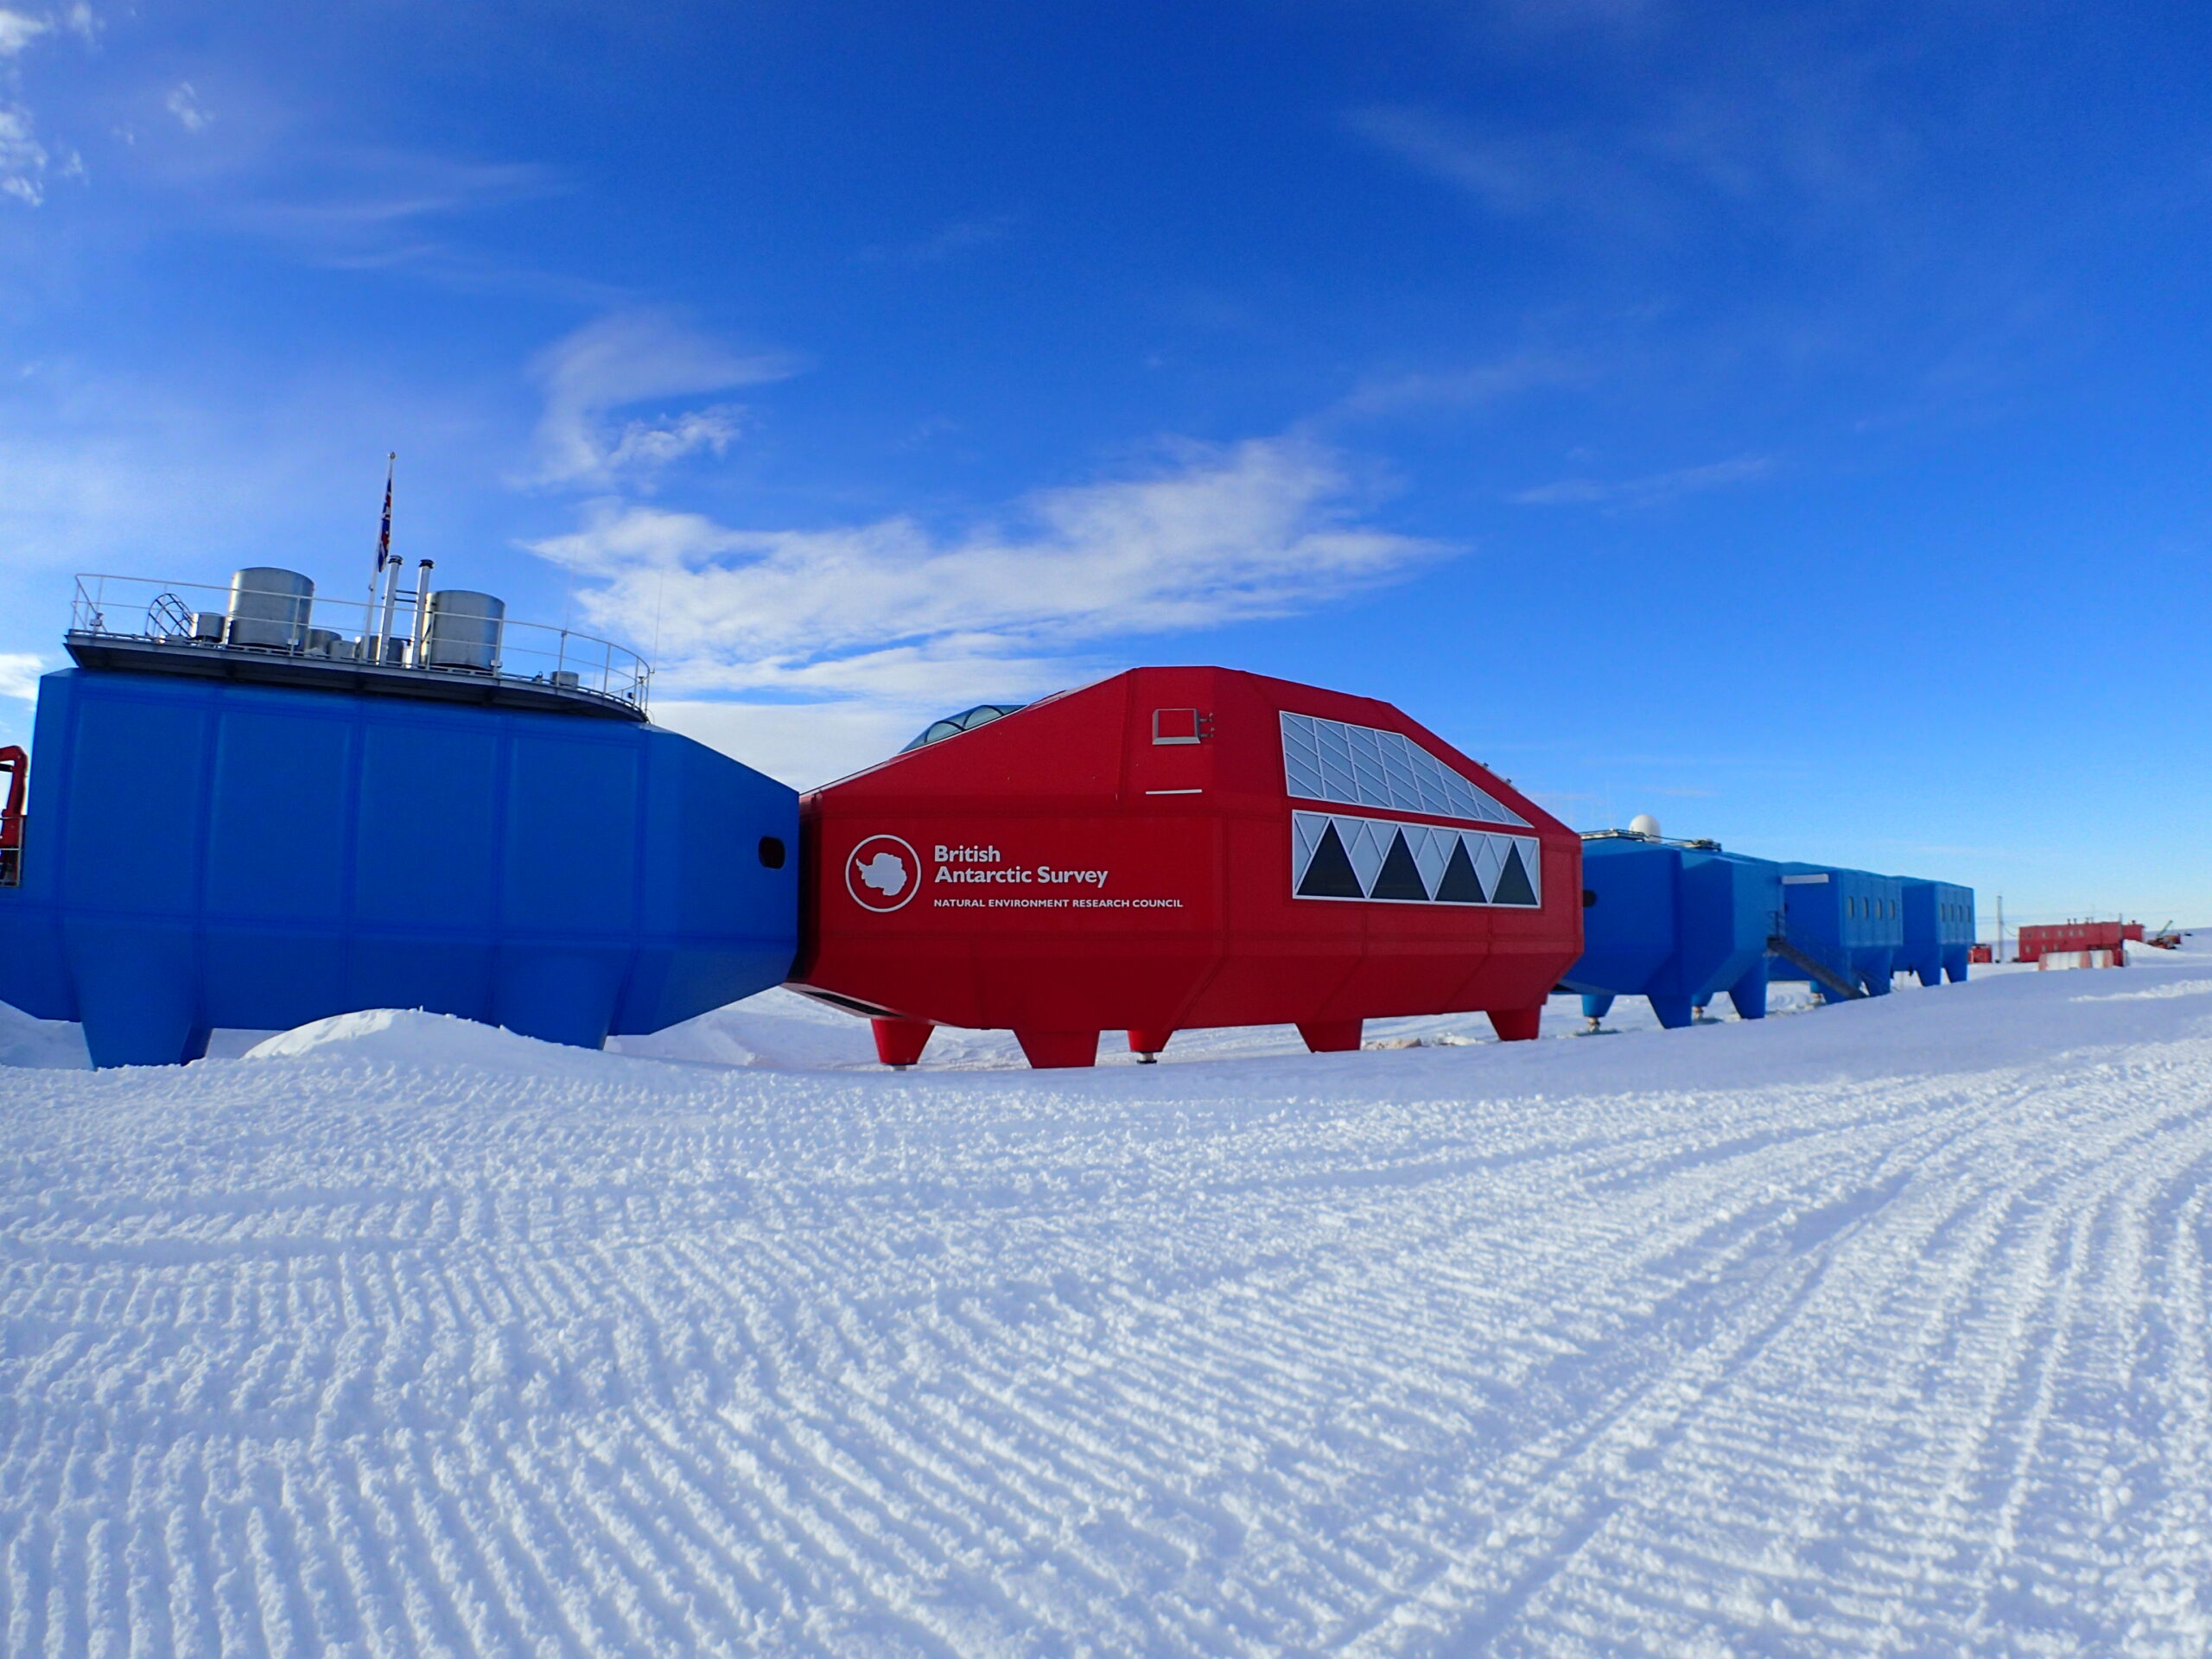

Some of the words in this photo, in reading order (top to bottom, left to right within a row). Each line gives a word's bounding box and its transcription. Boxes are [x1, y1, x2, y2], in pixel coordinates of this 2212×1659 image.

[934, 844, 1001, 862] British
[934, 865, 1033, 883] Antarctic
[1037, 866, 1109, 888] Survey
[933, 899, 986, 908] NATURAL
[988, 899, 1070, 908] ENVIRONMENT
[1072, 899, 1130, 908] RESEARCH
[1132, 899, 1184, 908] COUNCIL
